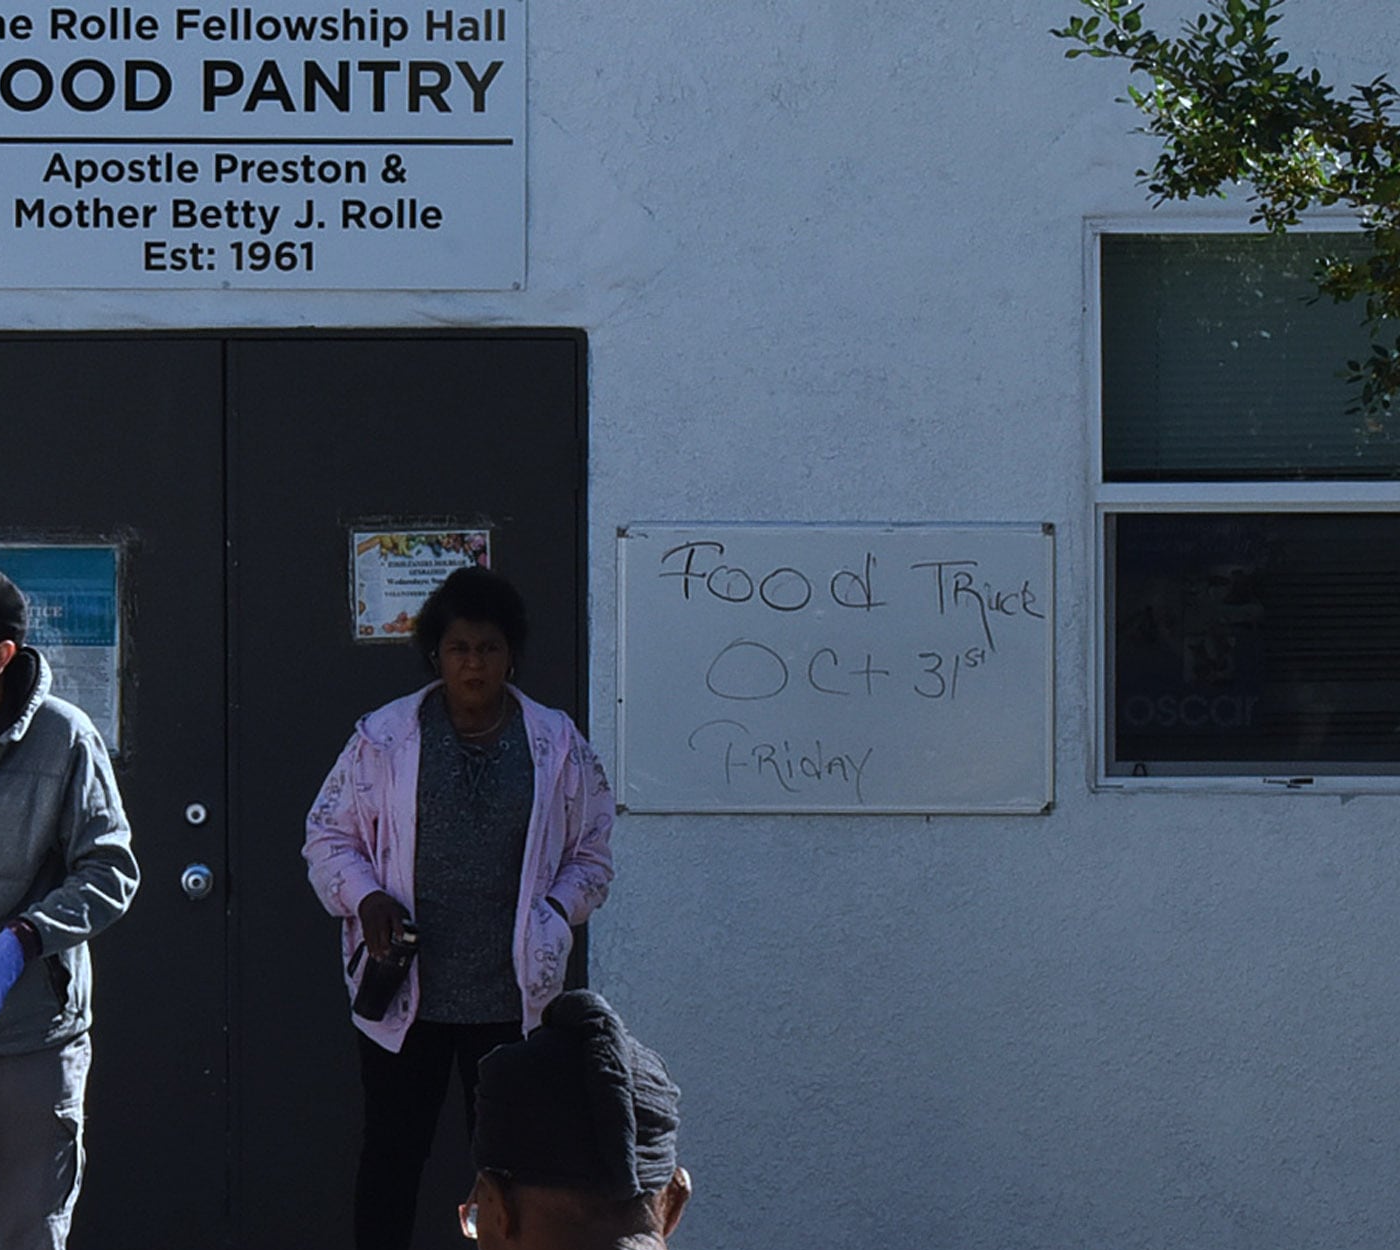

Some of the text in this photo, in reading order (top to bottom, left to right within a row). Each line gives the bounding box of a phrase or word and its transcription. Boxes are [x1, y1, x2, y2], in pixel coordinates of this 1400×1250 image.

[51, 8, 158, 40] Rolle
[177, 8, 408, 47] Fellowship
[427, 9, 504, 41] Hall
[204, 60, 503, 112] PANTRY
[43, 153, 406, 188] Apostle Preston &
[16, 198, 442, 235] Mother Betty J. Rolle
[145, 242, 312, 271] Est: 1961
